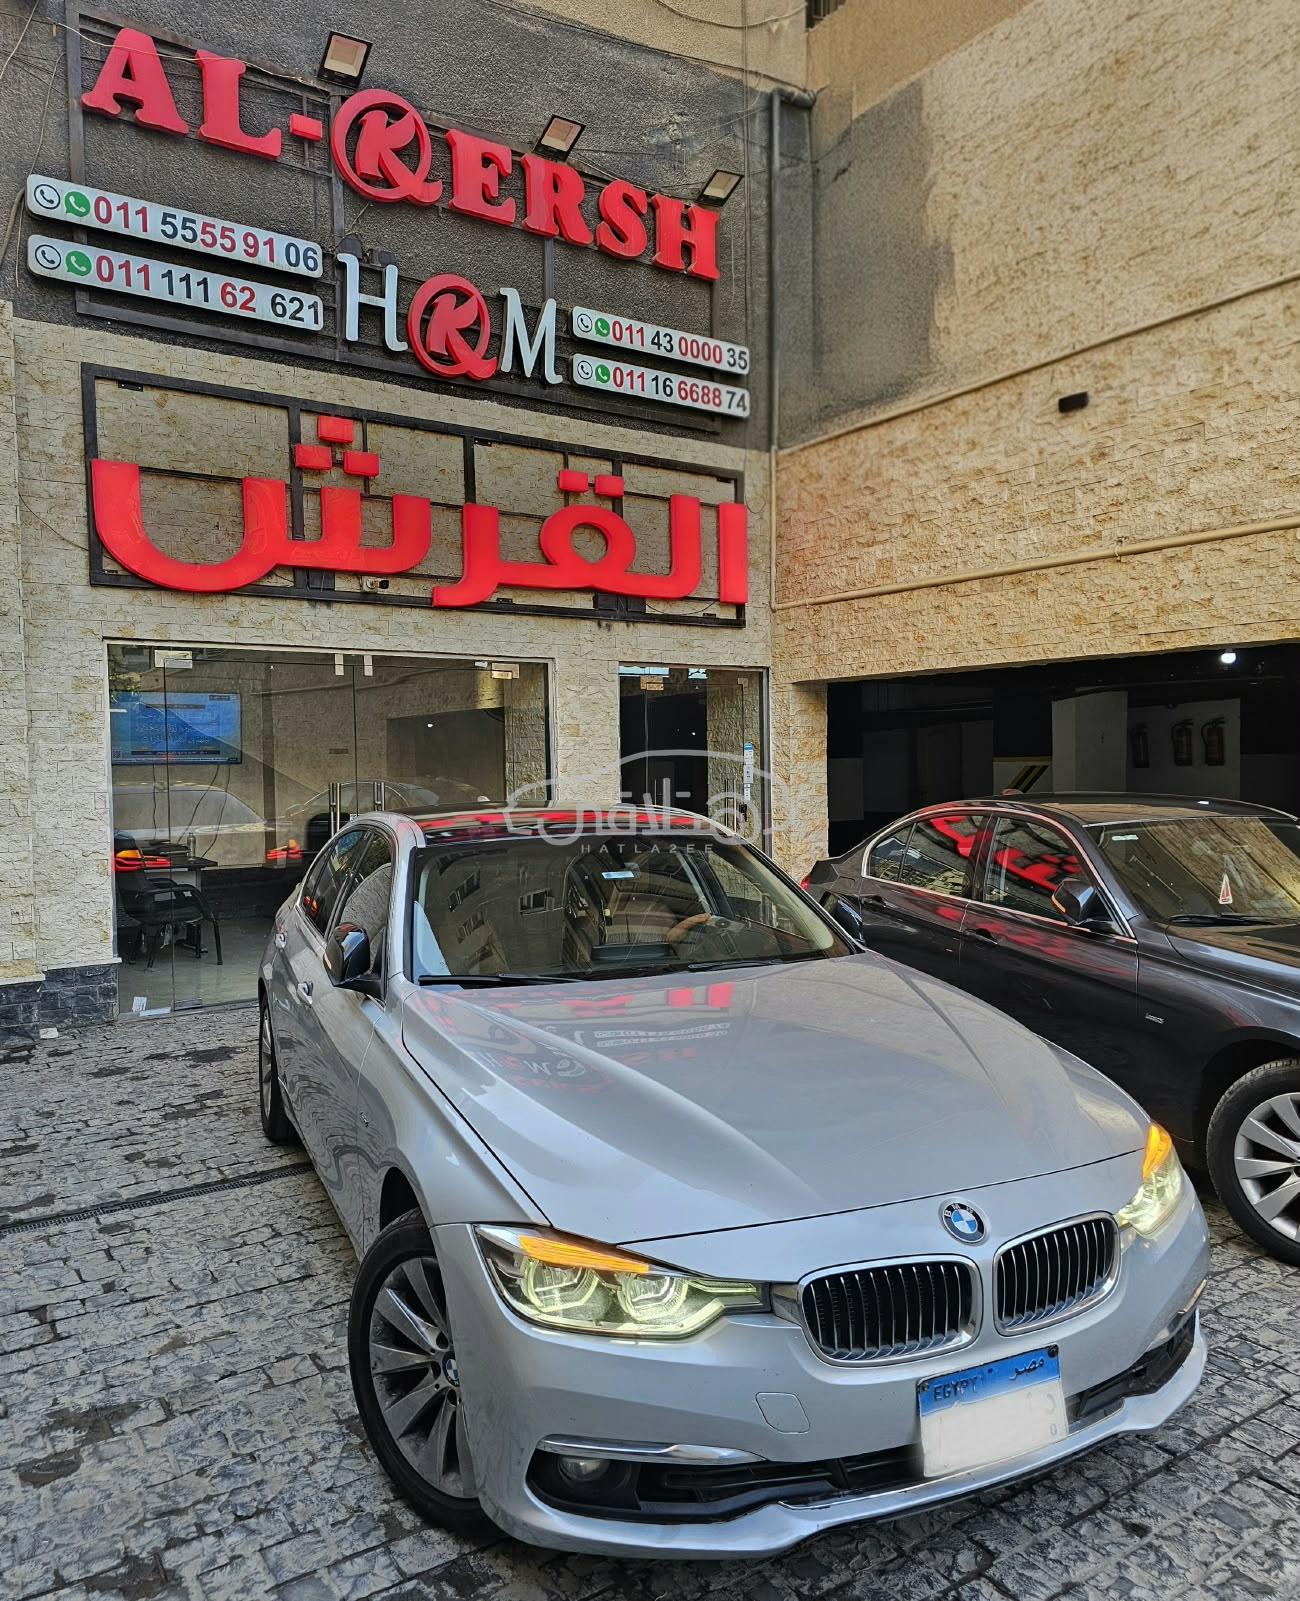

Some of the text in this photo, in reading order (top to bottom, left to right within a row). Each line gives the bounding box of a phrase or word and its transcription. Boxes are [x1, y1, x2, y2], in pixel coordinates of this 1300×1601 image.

[94, 196, 148, 233] 011
[284, 242, 319, 272] 06
[96, 255, 320, 325] 011 111 62 621
[611, 320, 748, 371] 011 43 0000 35
[612, 366, 748, 413] 011 16 6688 74
[91, 415, 748, 607] القرش
[933, 1376, 978, 1401] EGYPT
[1008, 1356, 1045, 1381] مصر
